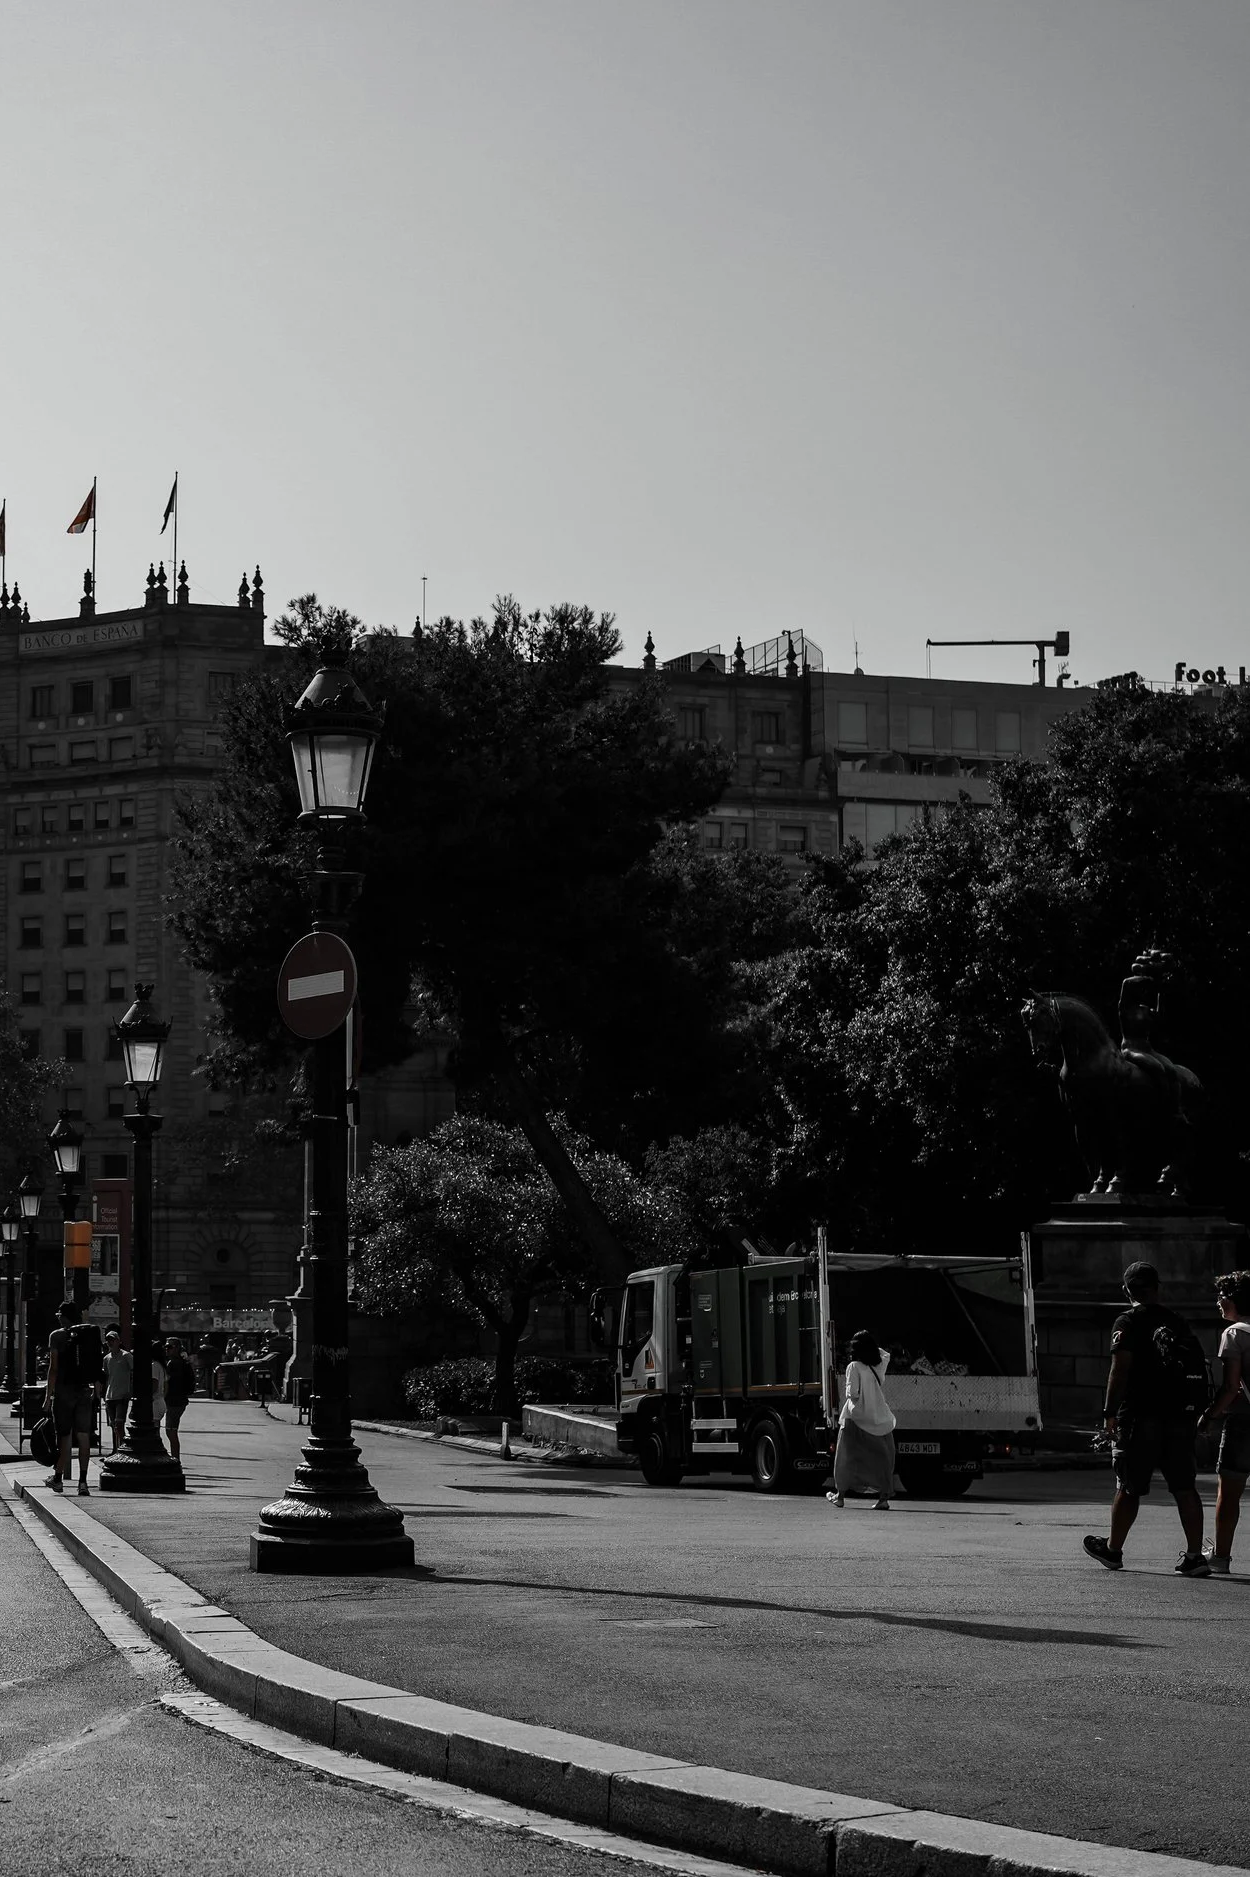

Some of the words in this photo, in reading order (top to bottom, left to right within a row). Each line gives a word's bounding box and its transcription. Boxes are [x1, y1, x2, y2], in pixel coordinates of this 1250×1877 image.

[24, 632, 71, 649] BANCO
[76, 635, 87, 644] DE
[93, 623, 138, 641] ESPAÑA
[1175, 662, 1226, 684] foot
